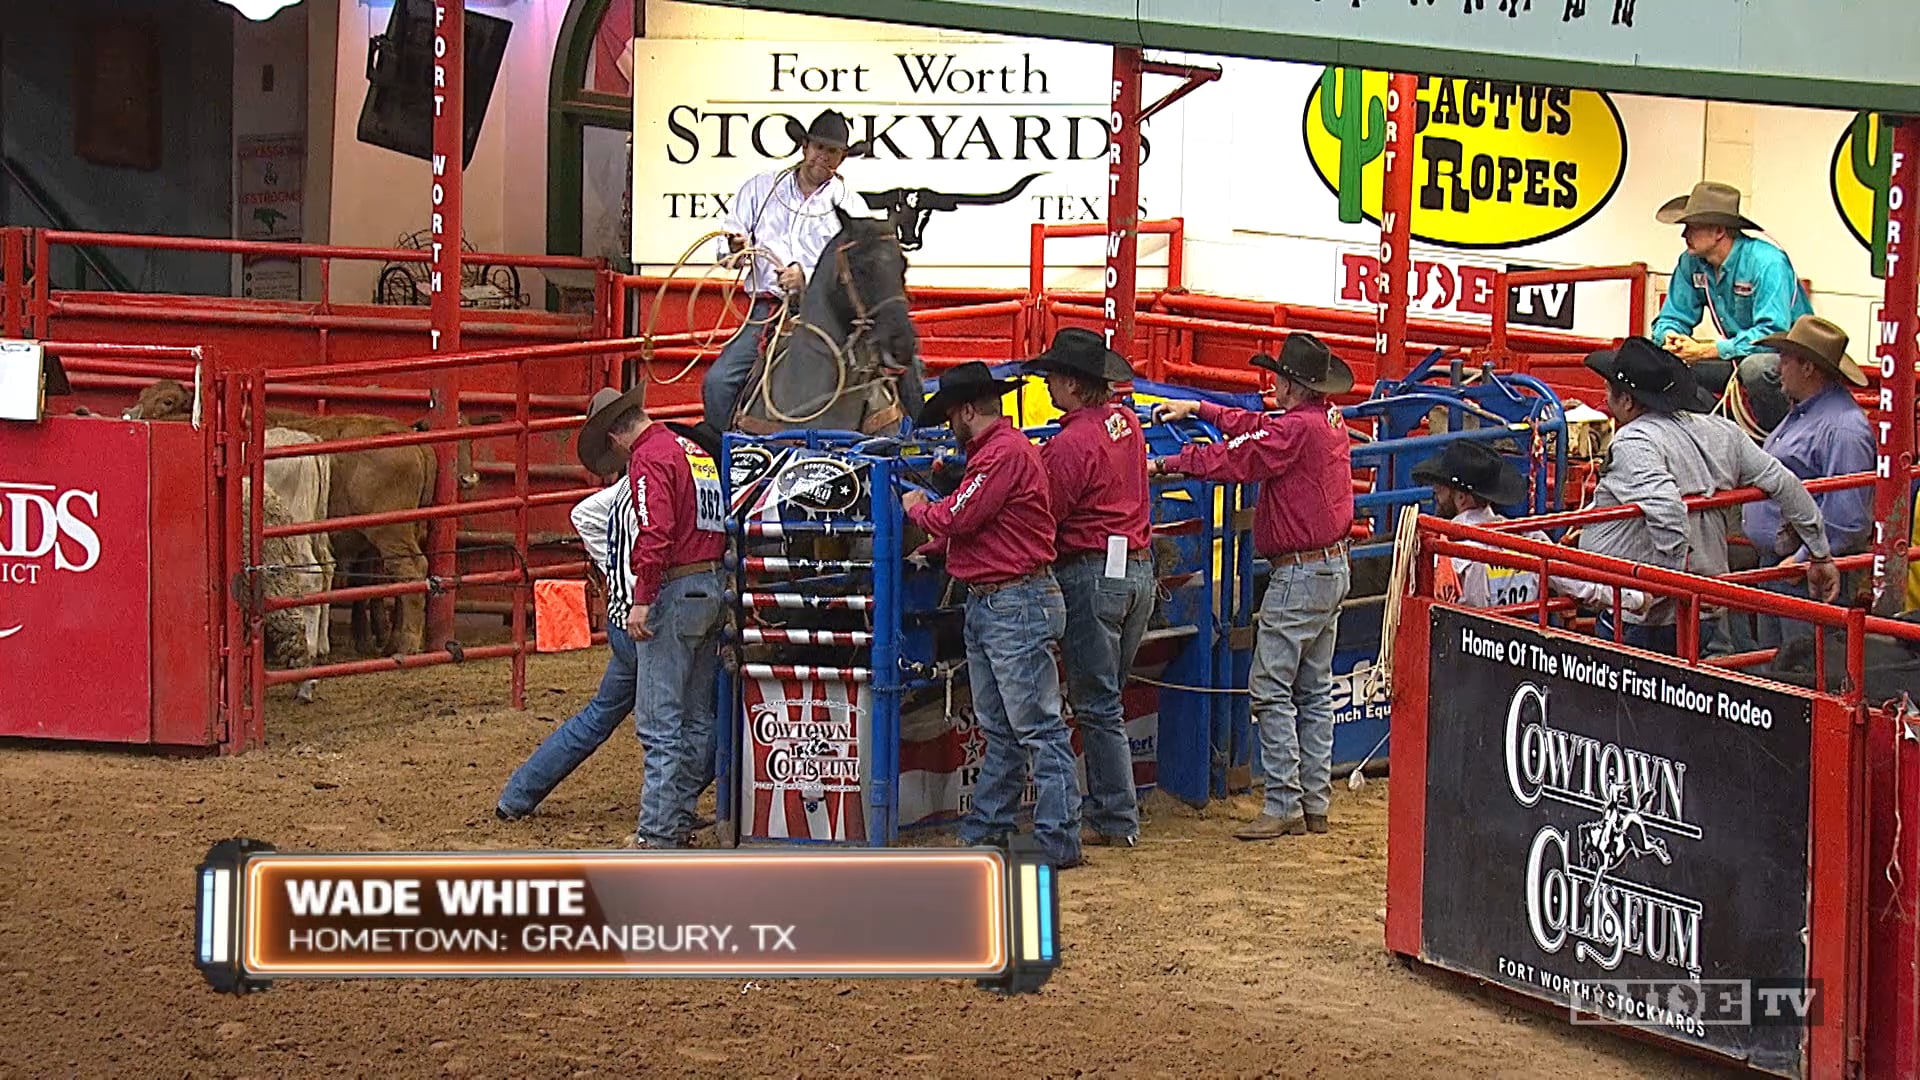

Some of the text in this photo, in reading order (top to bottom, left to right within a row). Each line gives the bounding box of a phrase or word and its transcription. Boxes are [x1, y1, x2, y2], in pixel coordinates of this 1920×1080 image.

[769, 52, 1051, 94] Fort Worth
[433, 7, 446, 292] FORT WORTH
[666, 105, 1151, 167] STOKYARD
[1419, 135, 1578, 213] ROPES
[663, 192, 735, 218] TEX
[1032, 194, 1149, 221] TEXS
[1104, 80, 1123, 350] FORT WORT
[1376, 88, 1399, 354] ORT WORTH
[1886, 152, 1904, 278] FORT
[1341, 253, 1568, 319] RDE TV
[1877, 320, 1899, 478] WORTH
[0, 488, 101, 573] DS
[1462, 628, 1773, 729] Home Of The World's First Indoor Rodeo
[754, 711, 851, 745] COWTOWN
[1504, 681, 1687, 822] COWTOWN
[1525, 825, 1703, 971] COLISEUM
[1498, 957, 1706, 1038] FORT WORTH STOCKYARDS
